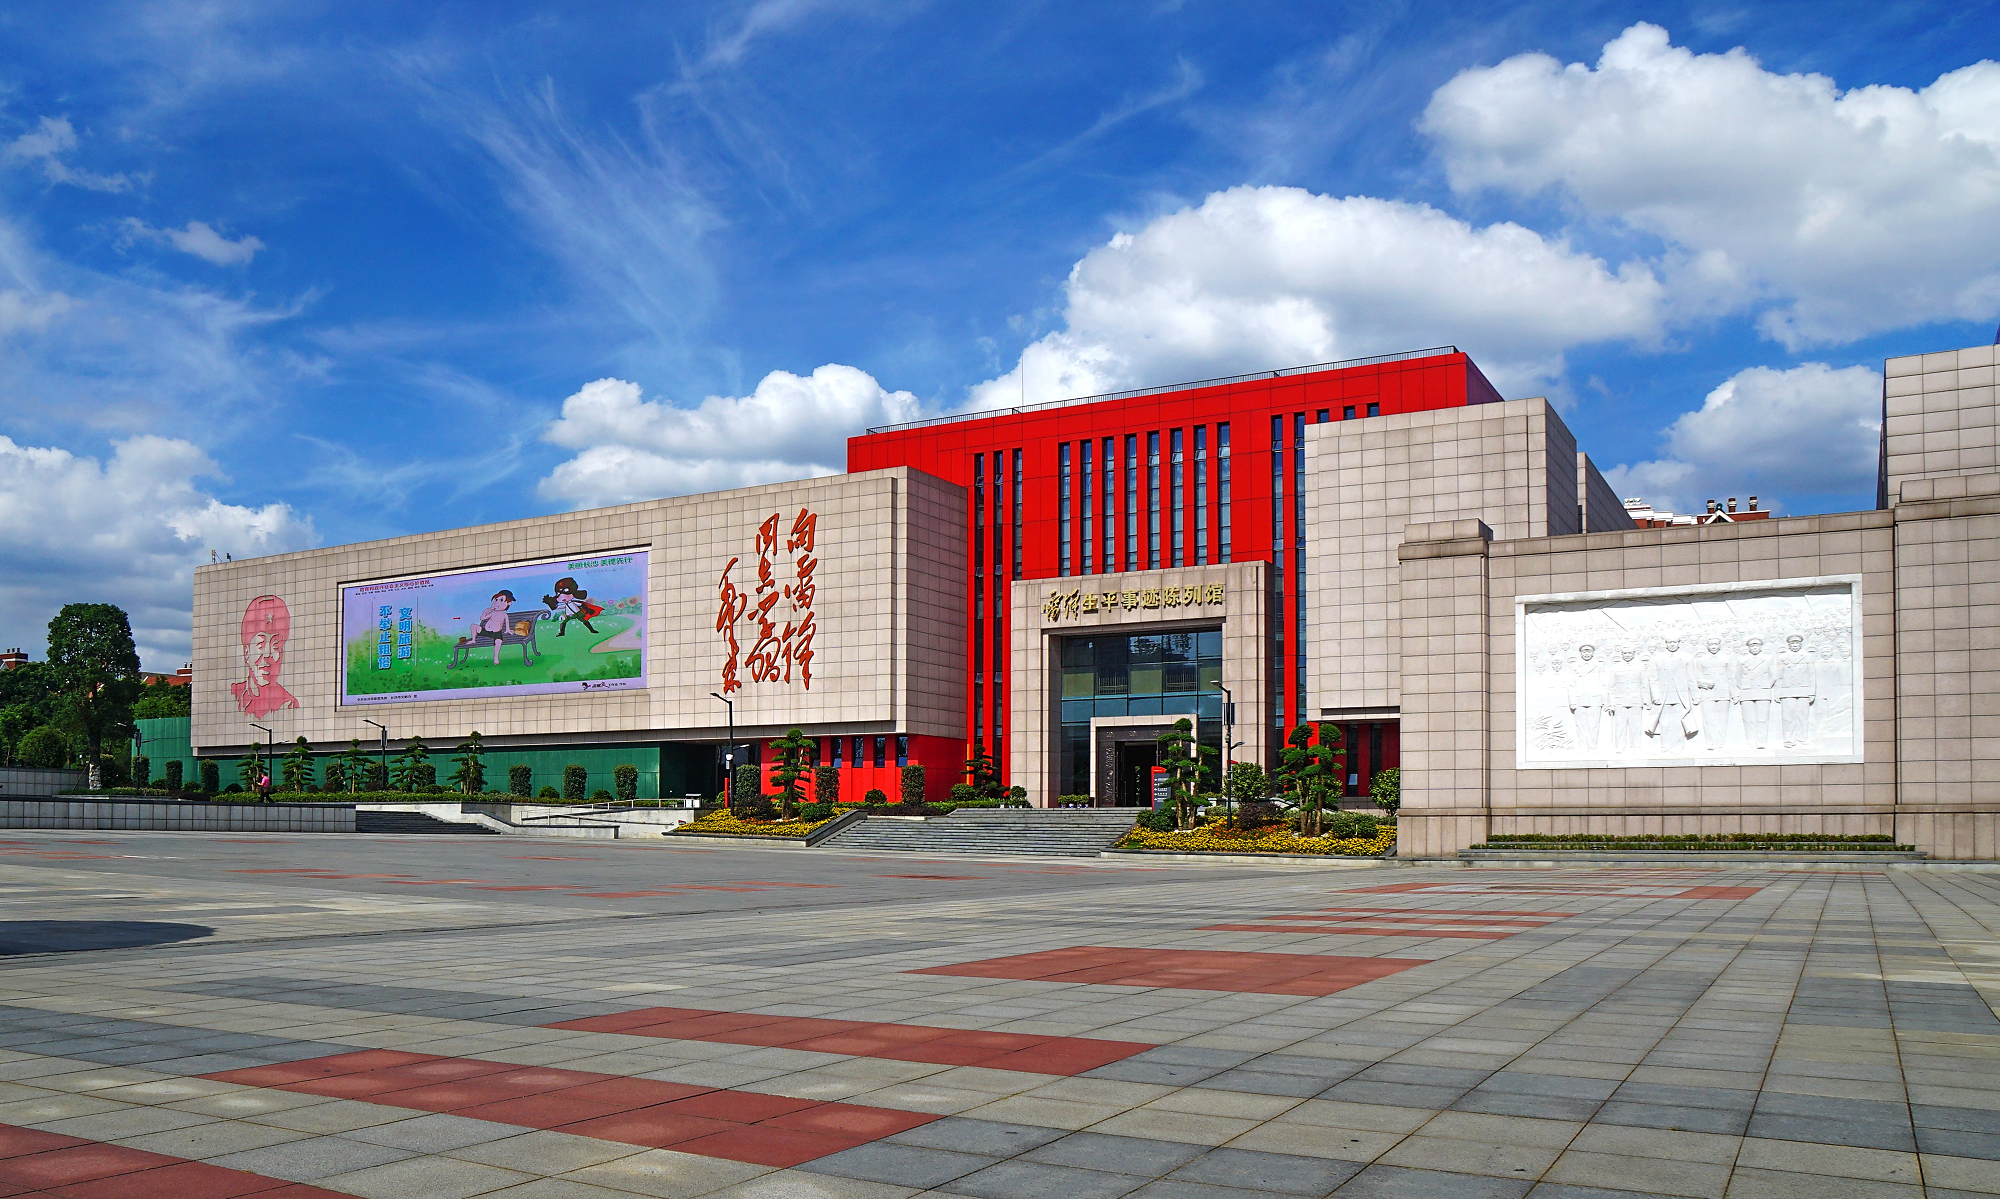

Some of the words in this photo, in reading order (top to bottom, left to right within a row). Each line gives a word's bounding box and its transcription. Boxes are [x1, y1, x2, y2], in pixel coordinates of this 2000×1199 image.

[1042, 583, 1225, 621] 雷锋生平事迹陈列馆
[378, 604, 392, 670] 不举止粗俗
[398, 607, 412, 659] 文明旅游
